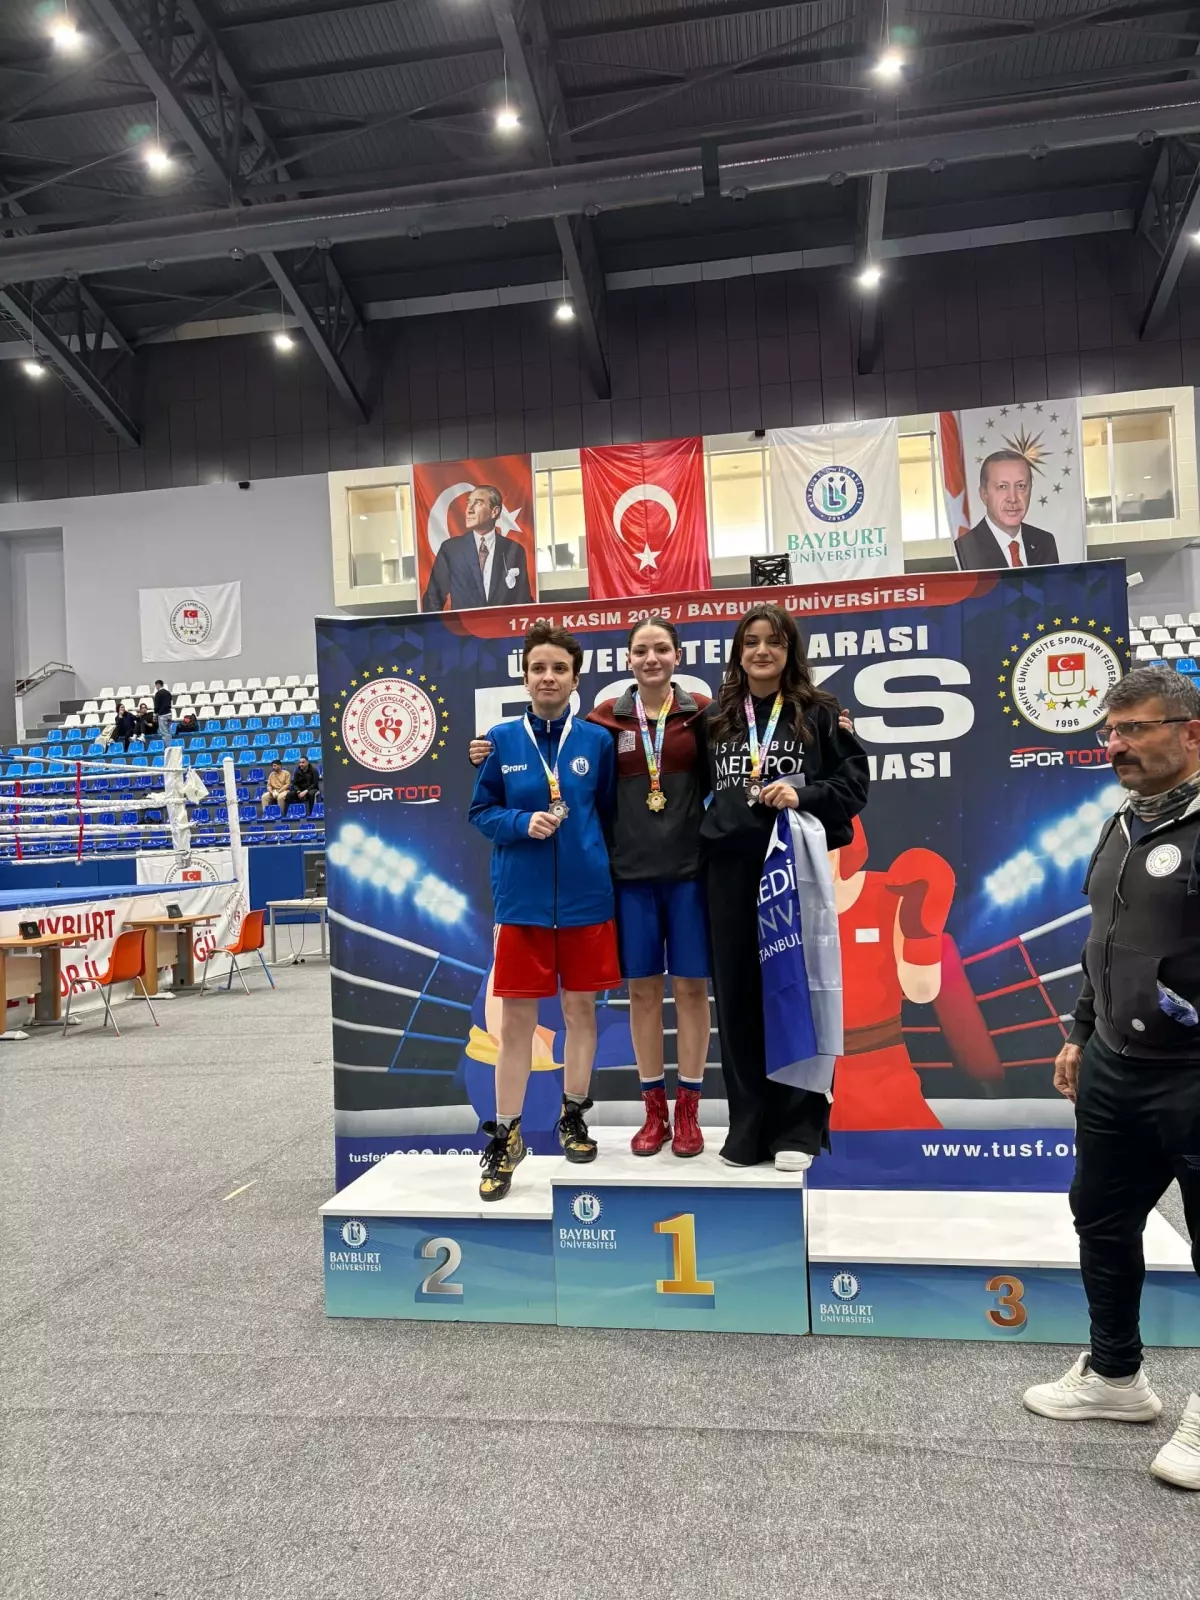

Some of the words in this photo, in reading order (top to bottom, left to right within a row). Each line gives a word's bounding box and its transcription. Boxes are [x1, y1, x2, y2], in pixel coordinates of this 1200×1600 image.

[787, 527, 886, 551] BAYBURT
[789, 544, 888, 564] ÜNİVERSİTESİ
[562, 612, 621, 628] KASIM
[627, 606, 672, 623] 2025
[676, 605, 682, 619] /
[784, 583, 925, 612] ÜNİVERSİTESİ
[1058, 636, 1102, 656] SPORLARI
[1016, 639, 1056, 683] ÜNİVERSİTE
[1018, 686, 1040, 720] TÜRKİYE
[362, 734, 382, 754] TÜRKİYE
[380, 696, 404, 704] GENÇLİK
[410, 708, 419, 725] SPOR
[1055, 718, 1080, 728] 1996
[559, 1228, 616, 1241] BAYBURT
[560, 1239, 617, 1250] ÜNİVERSİTESİ
[329, 1251, 381, 1264] BAYBURT
[653, 1212, 715, 1295] 1
[329, 1262, 382, 1272] ÜNİVERSİTESİ
[421, 1237, 464, 1294] 2
[820, 1303, 873, 1316] BAYBURT
[985, 1275, 1028, 1328] 3
[820, 1314, 874, 1325] ÜNİVERSİTESİ
